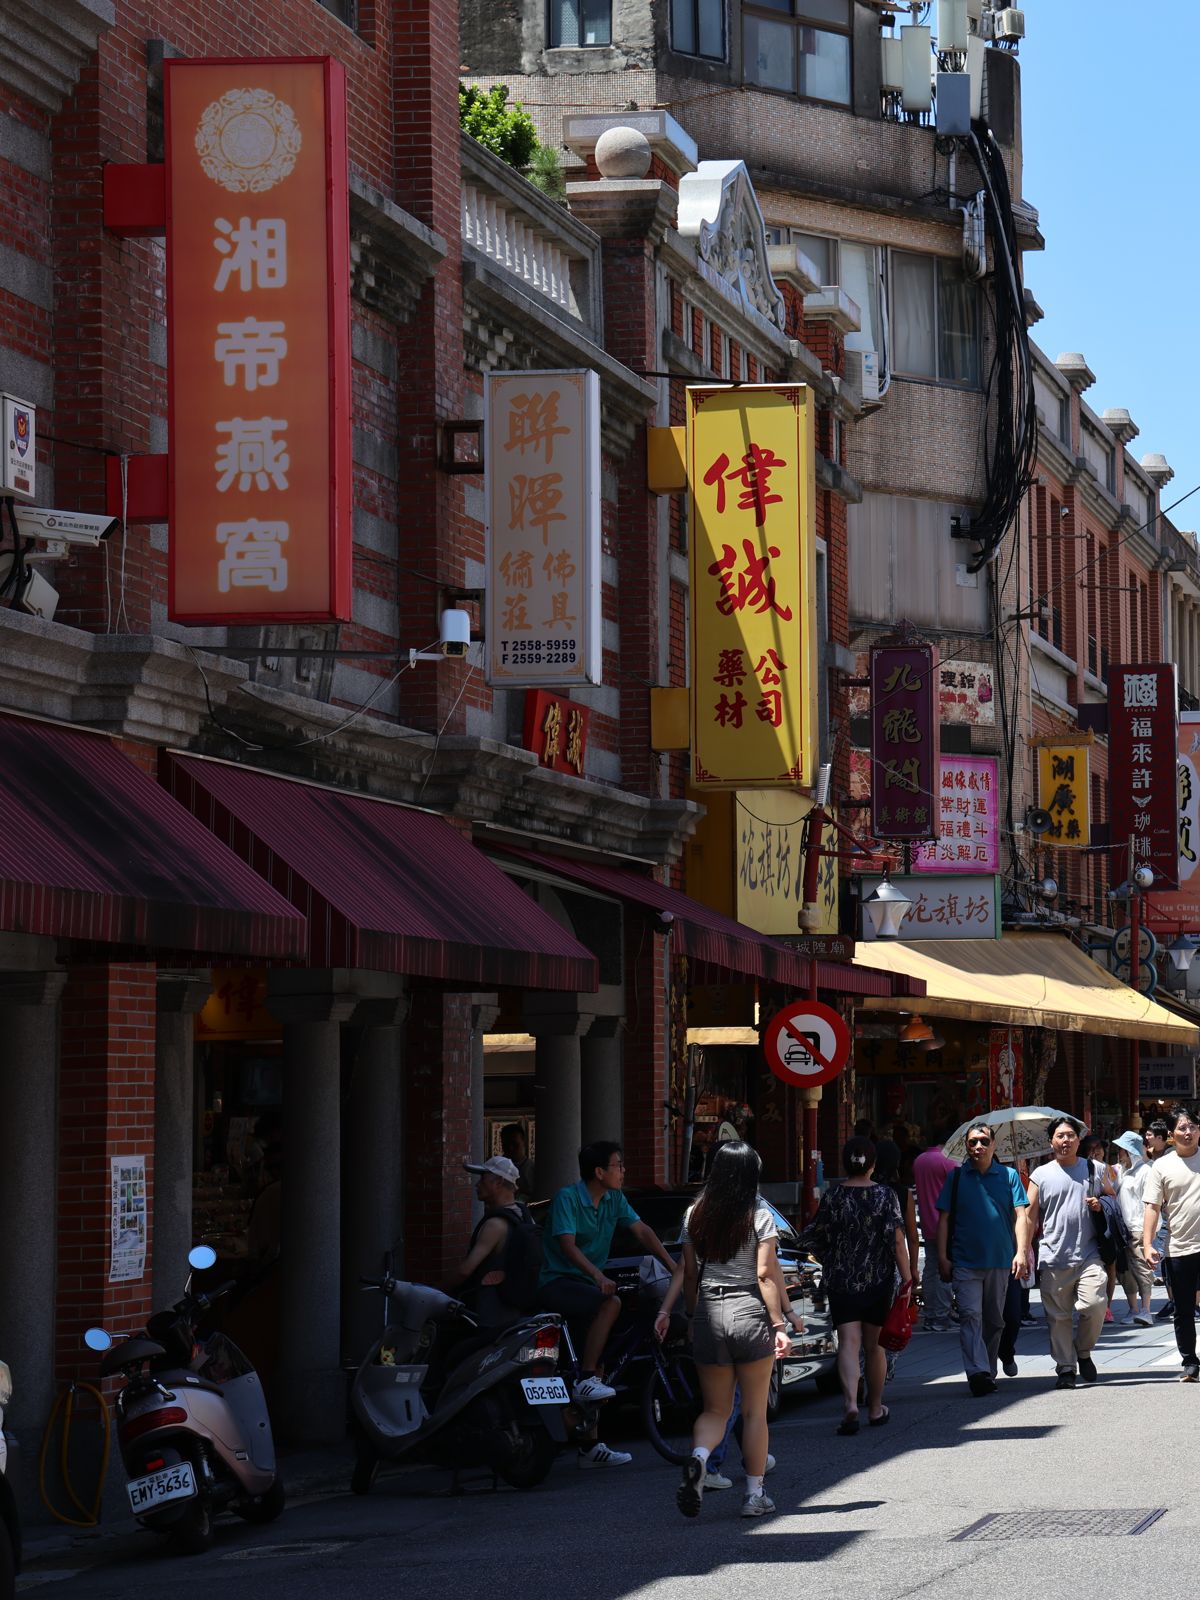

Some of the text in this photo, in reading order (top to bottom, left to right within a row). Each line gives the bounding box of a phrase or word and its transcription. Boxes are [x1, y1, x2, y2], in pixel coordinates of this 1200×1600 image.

[212, 216, 290, 594] 湘帝燕窩
[702, 443, 793, 622] 偉誠
[541, 548, 577, 631] 佛具
[501, 639, 576, 651] T 2558-5959
[502, 652, 576, 664] F 2559-2289
[712, 648, 748, 730] 藥材
[753, 648, 788, 730] 公司
[1130, 717, 1153, 789] 福來許
[940, 797, 988, 815] 業財運
[940, 820, 988, 839] 福禮斗
[923, 844, 989, 862] 消災解厄
[904, 892, 989, 926] 花旗坊
[525, 1386, 567, 1401] 052-BGX
[131, 1472, 191, 1507] EMY-5636
